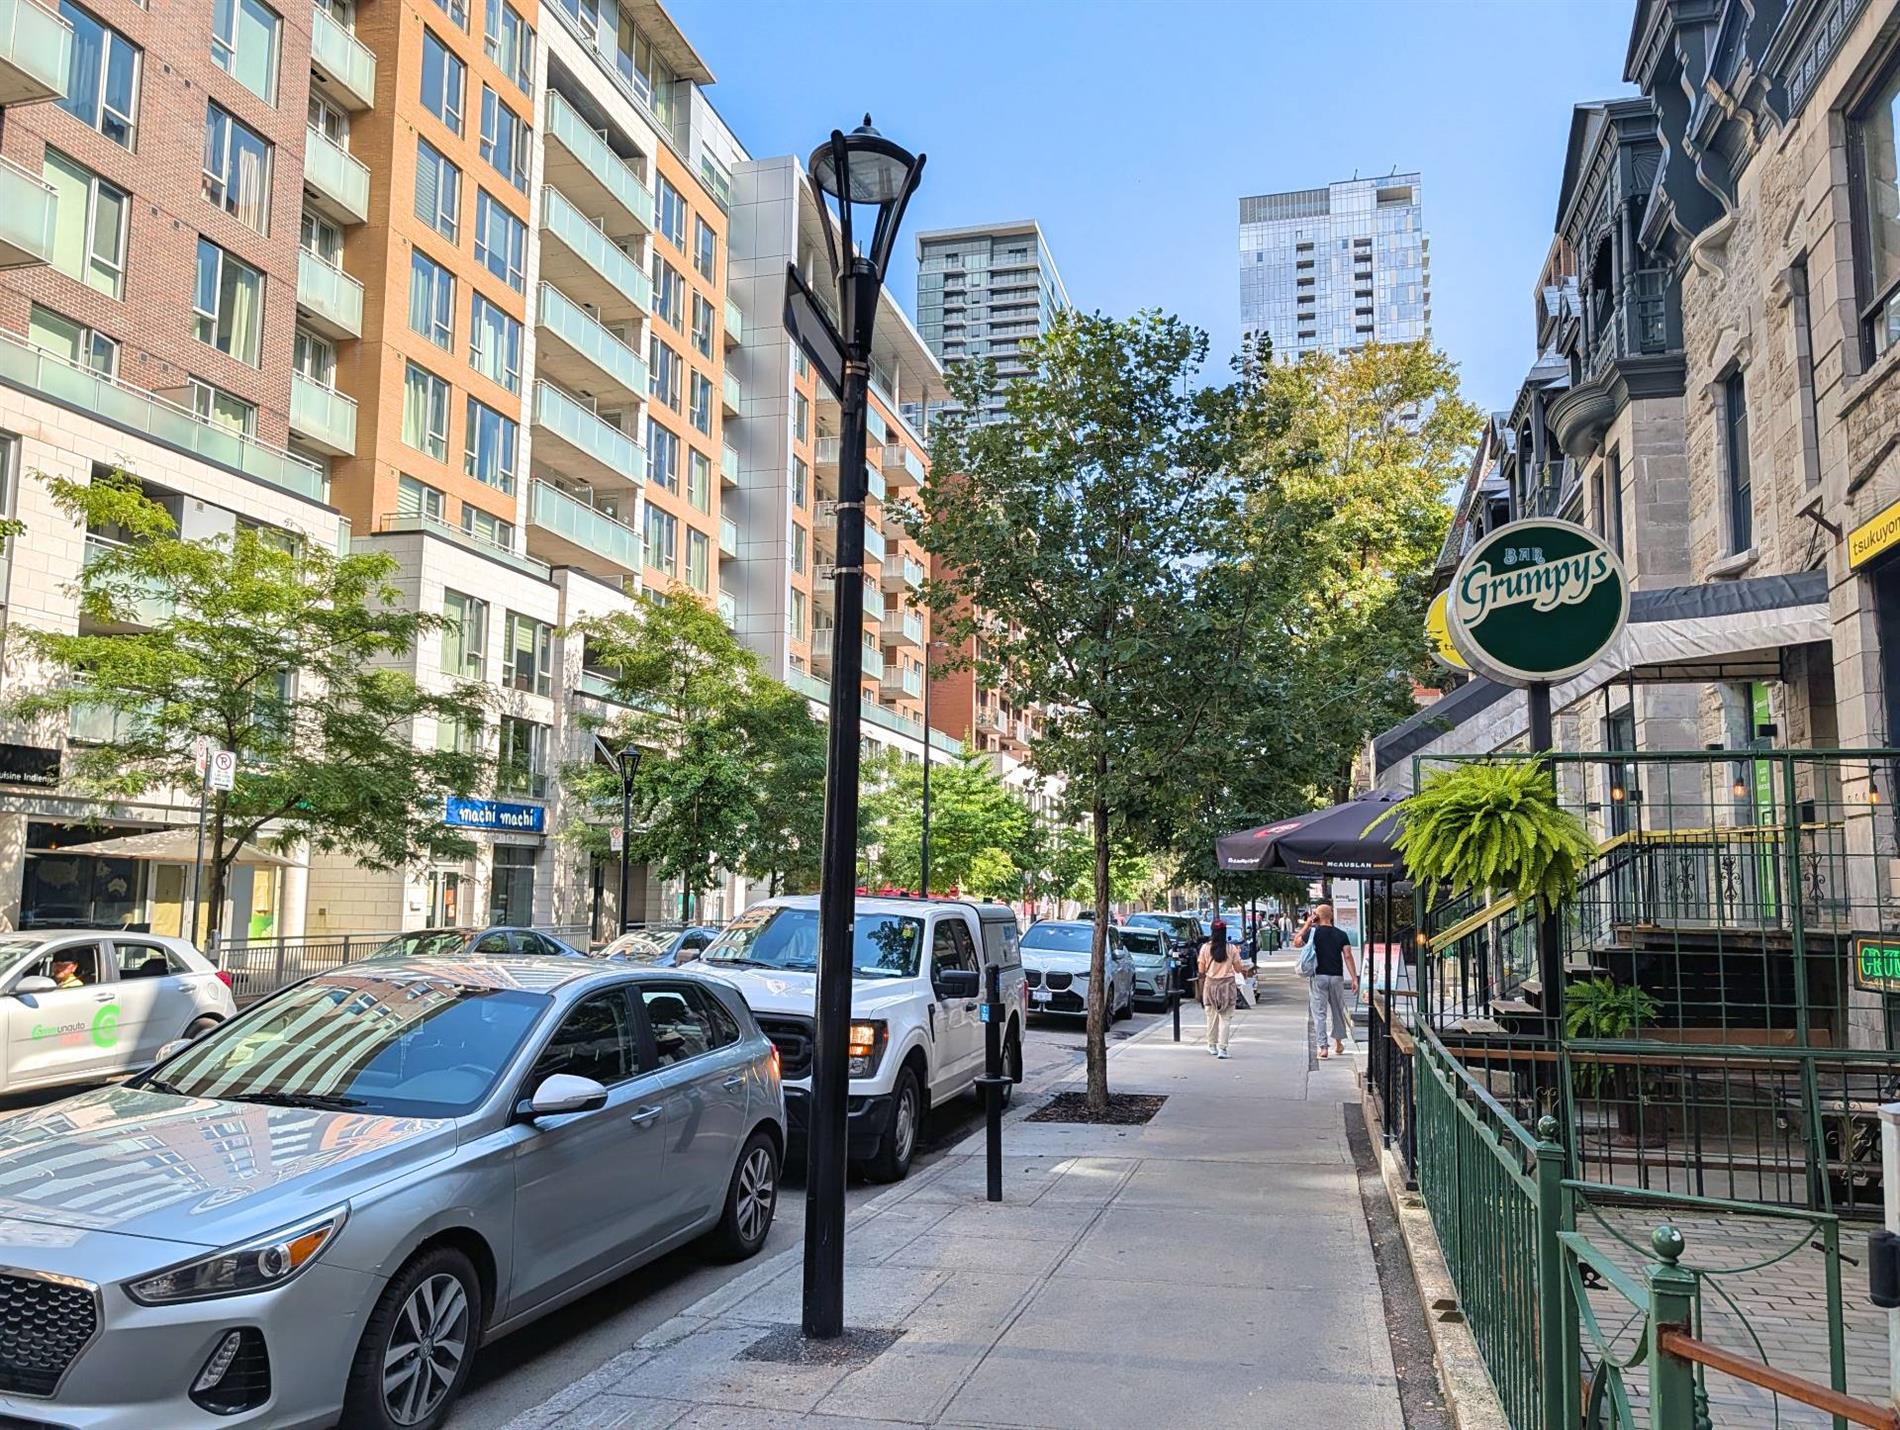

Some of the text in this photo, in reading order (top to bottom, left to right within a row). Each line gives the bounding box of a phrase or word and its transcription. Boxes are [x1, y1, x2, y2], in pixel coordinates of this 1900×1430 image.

[1503, 547, 1546, 565] BAR
[1461, 551, 1607, 625] Grumpys
[459, 804, 534, 826] machi machi
